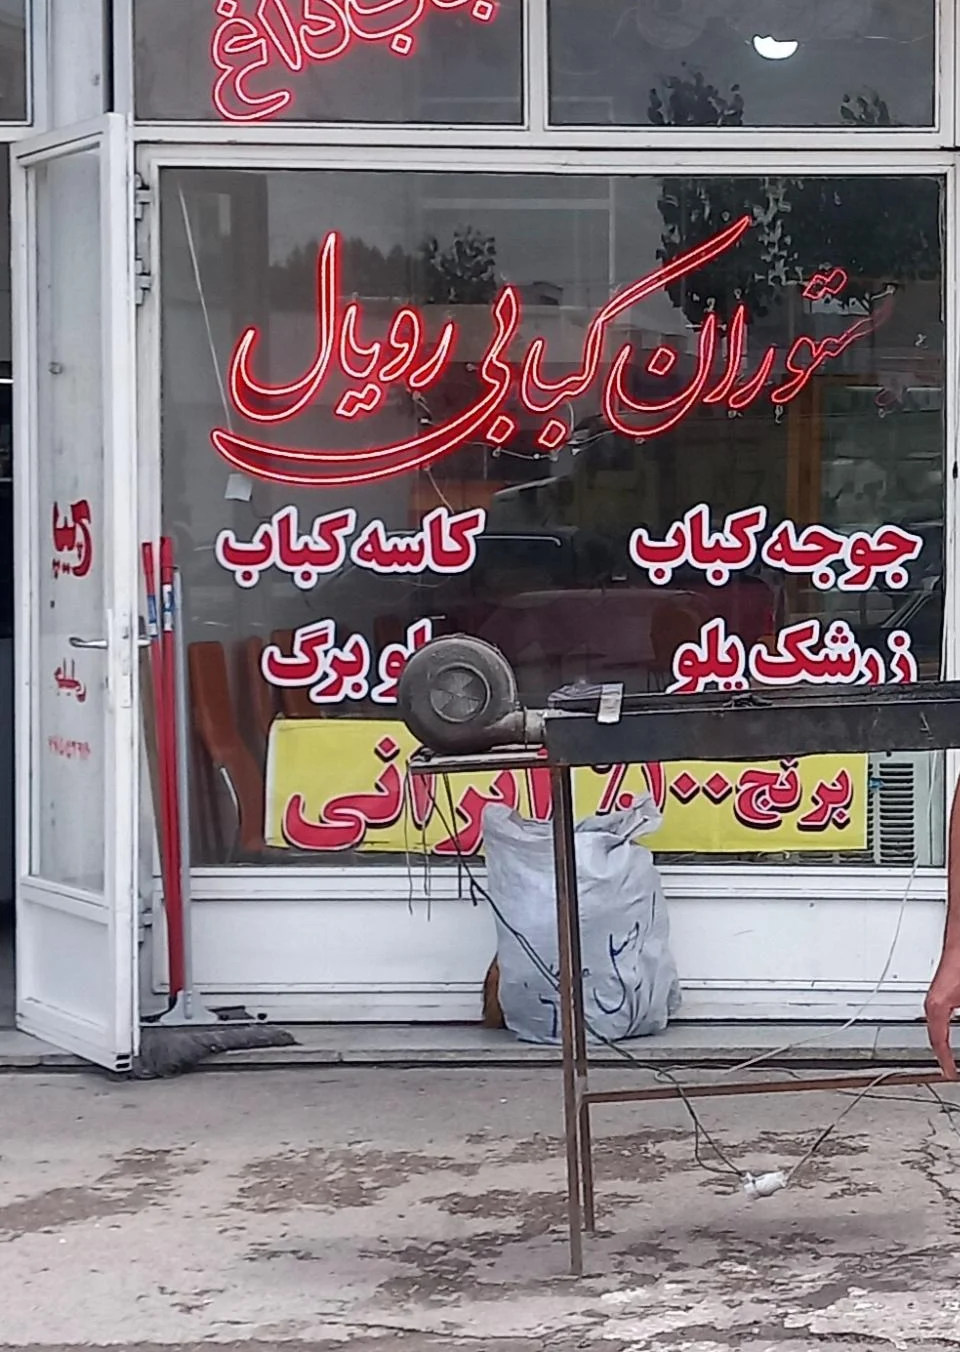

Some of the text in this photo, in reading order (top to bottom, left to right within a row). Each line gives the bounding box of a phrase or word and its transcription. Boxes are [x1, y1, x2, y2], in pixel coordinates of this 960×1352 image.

[212, 214, 751, 485] کبابی
[230, 232, 455, 422] رویال
[216, 505, 486, 589] کاسه کباب
[629, 503, 923, 590] جوجه کباب
[261, 619, 370, 704] برگ
[749, 619, 918, 686] زرشک
